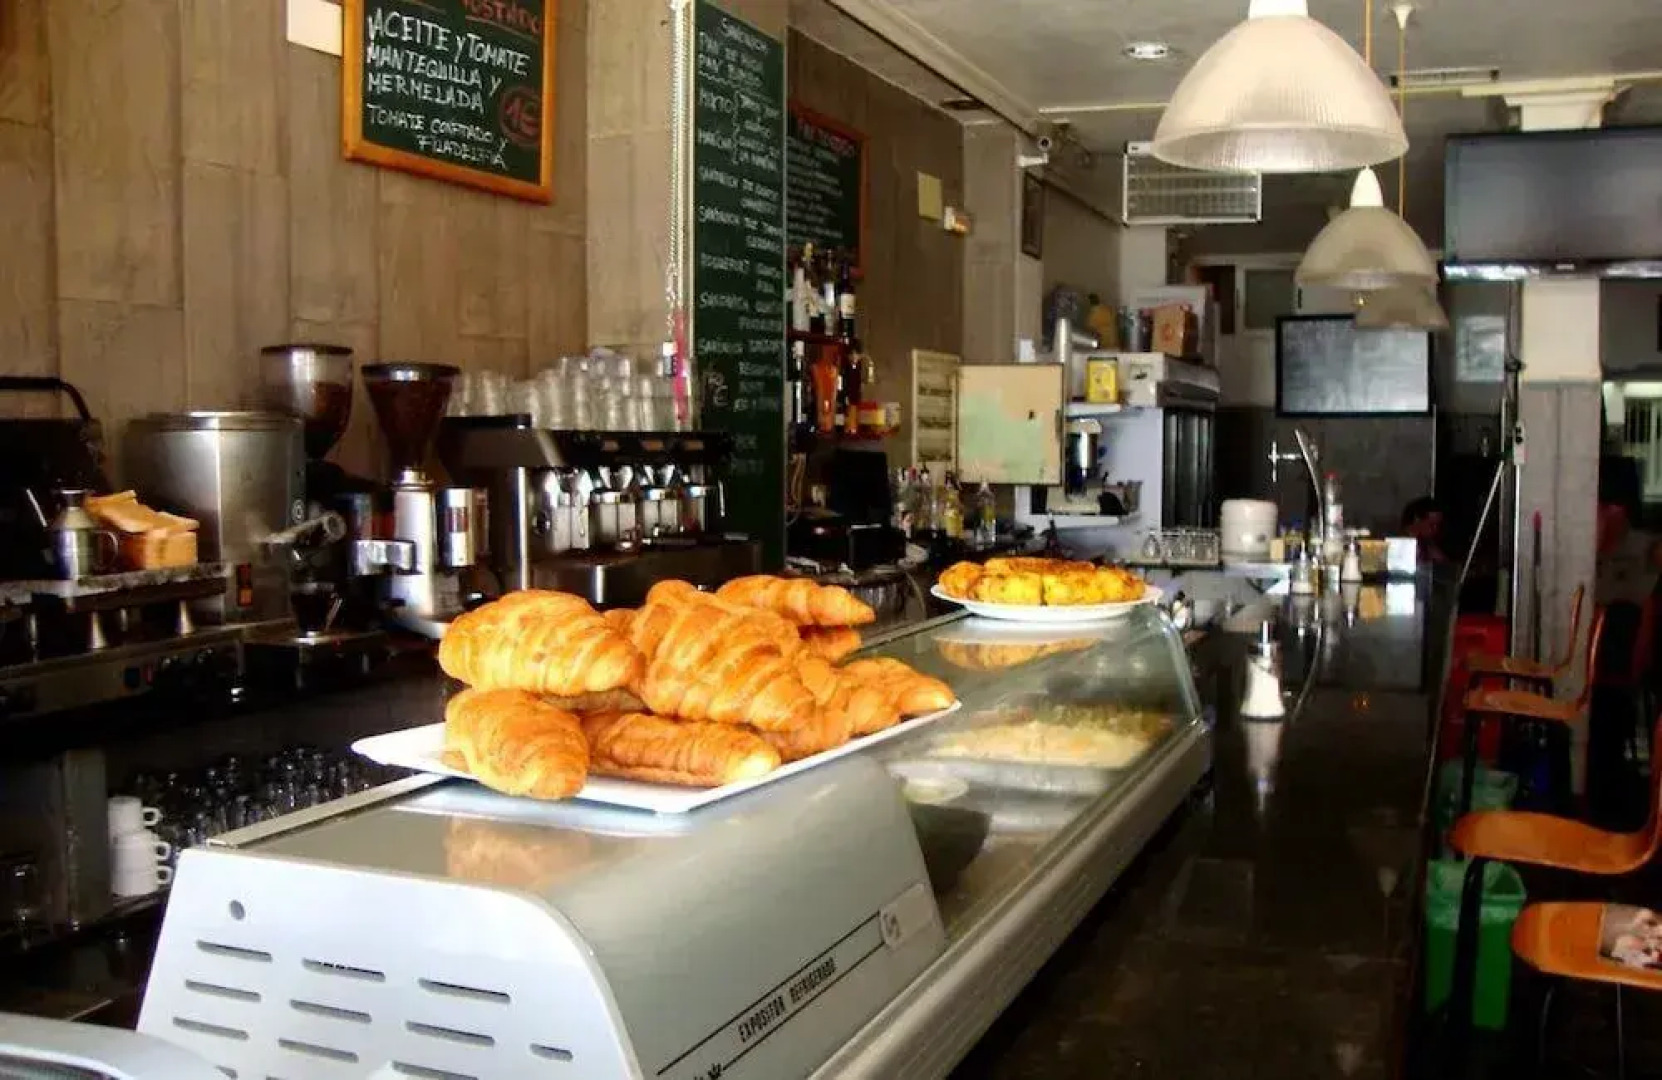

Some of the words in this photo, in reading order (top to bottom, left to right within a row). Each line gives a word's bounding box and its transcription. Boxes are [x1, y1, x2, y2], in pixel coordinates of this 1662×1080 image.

[366, 41, 482, 89] MANTEQUILLA
[367, 7, 450, 52] ACEITE
[466, 32, 531, 76] TOMATE
[366, 102, 426, 131] TOMATE
[367, 72, 485, 114] MERMELADA
[738, 995, 786, 1043] EXPOSITOR
